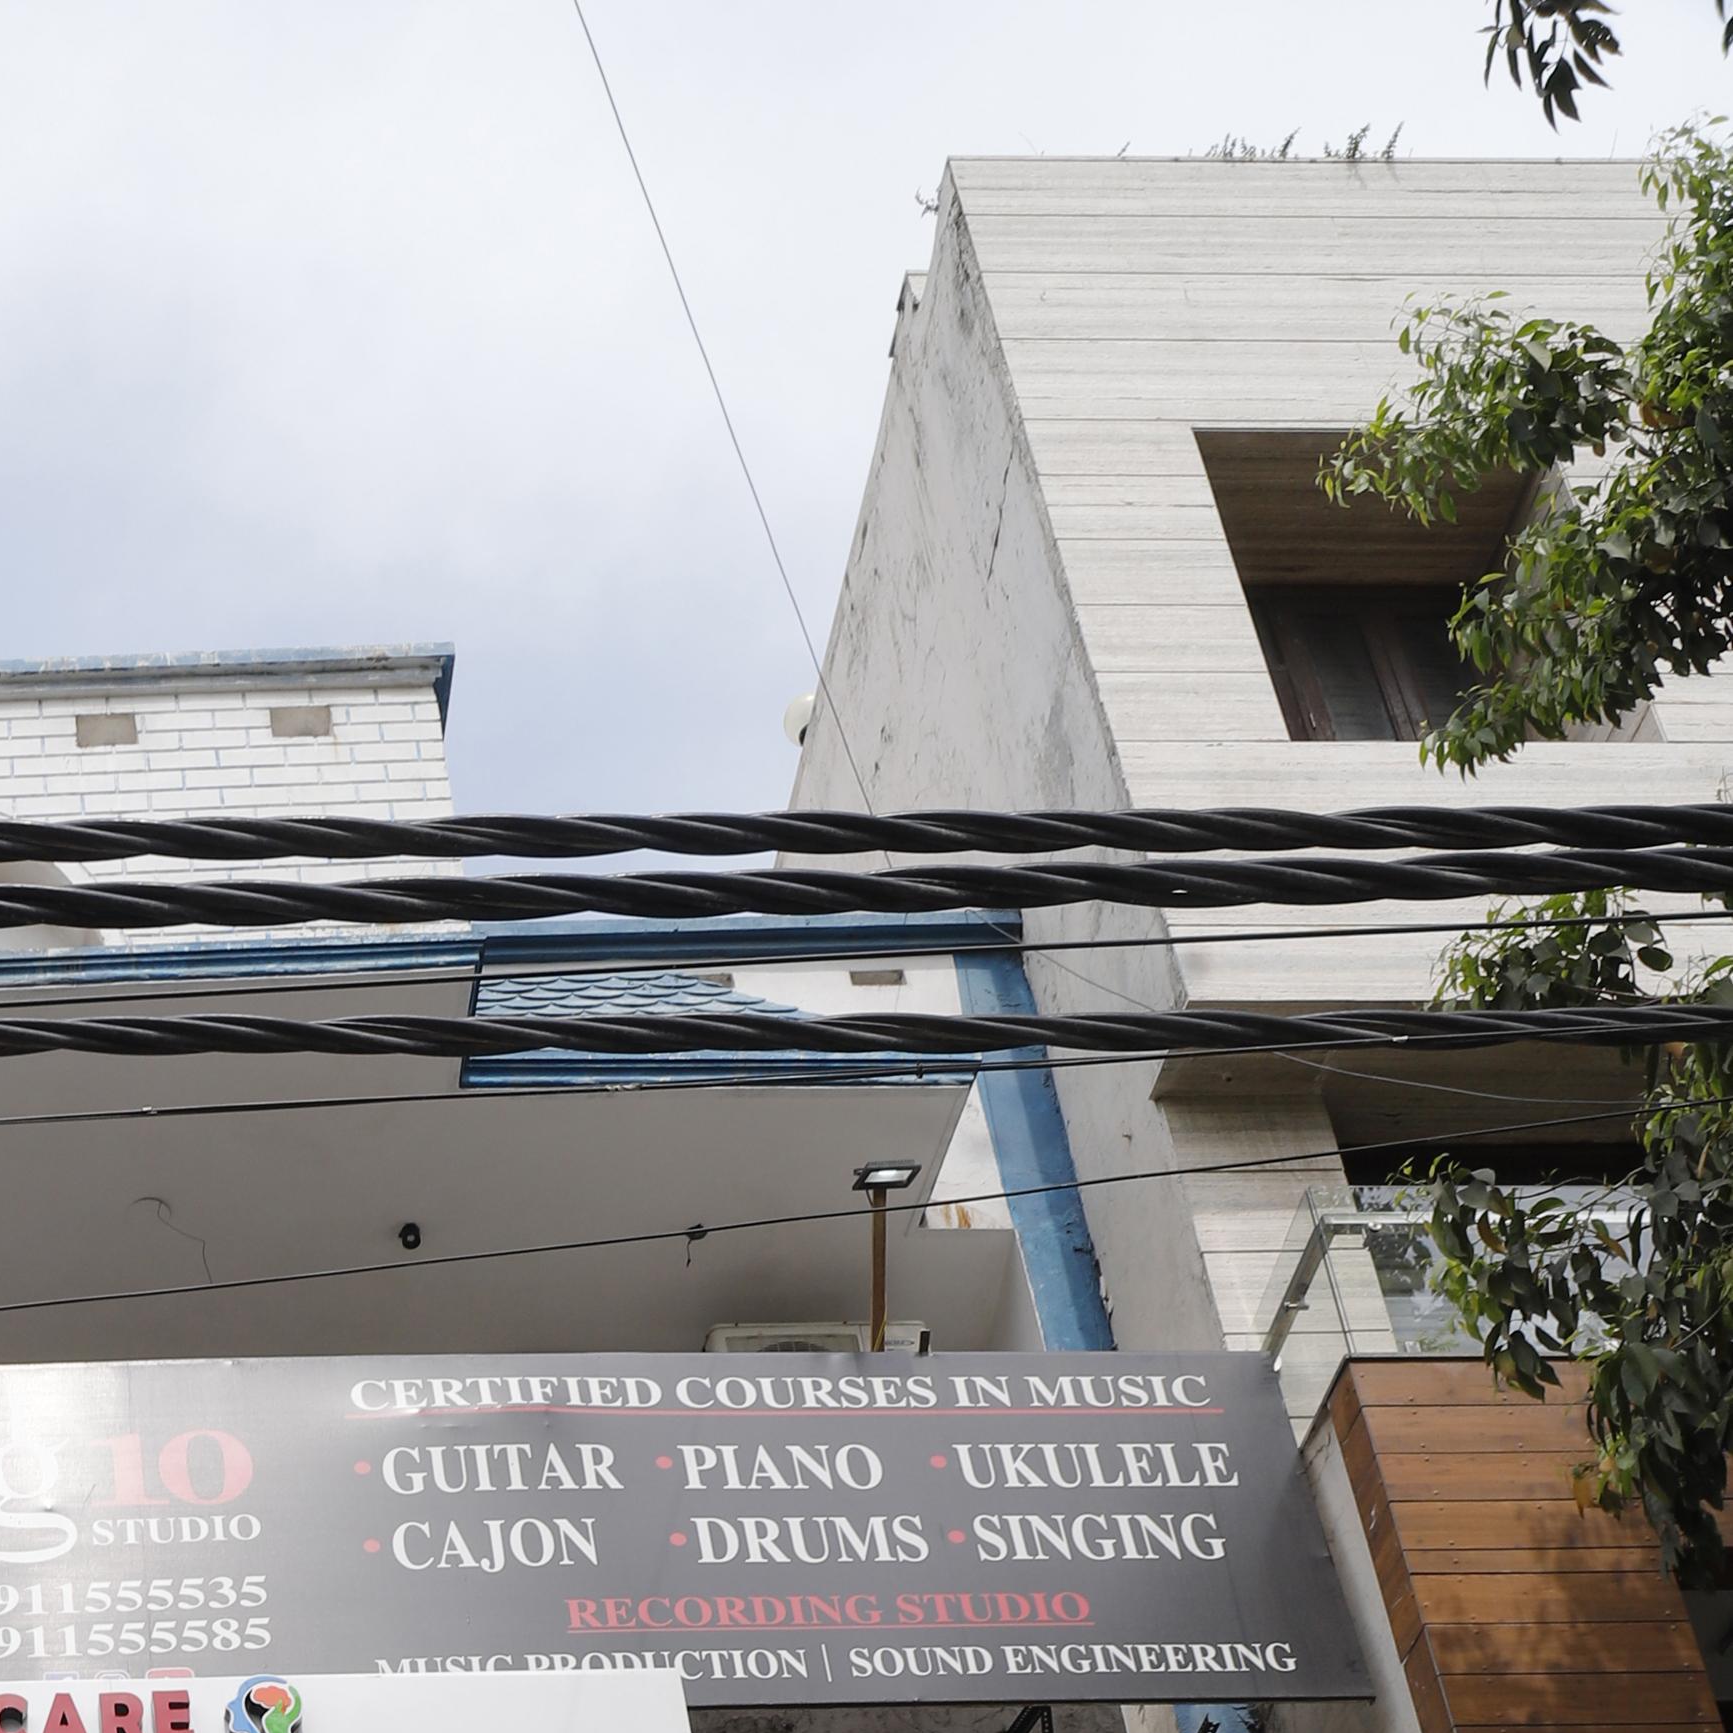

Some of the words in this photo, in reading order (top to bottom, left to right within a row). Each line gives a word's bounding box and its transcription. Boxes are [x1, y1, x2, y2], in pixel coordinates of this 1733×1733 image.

[350, 1377, 662, 1411] CERTIFIED
[675, 1375, 937, 1408] COURSES
[954, 1375, 1009, 1408] IN
[1028, 1374, 1211, 1408] MUSIC
[382, 1442, 624, 1494] GUITAR
[676, 1444, 884, 1490] PIANO
[953, 1442, 1239, 1489] UKULELE
[92, 1514, 261, 1548] STUDIO
[392, 1519, 599, 1573] CAJON
[690, 1515, 930, 1564] DRUMS
[976, 1514, 1226, 1562] SINGING
[567, 1593, 882, 1629] RECORDING
[896, 1591, 1092, 1624] STUDIO
[850, 1646, 992, 1678] SOUND
[1006, 1642, 1297, 1675] ENGINEERING
